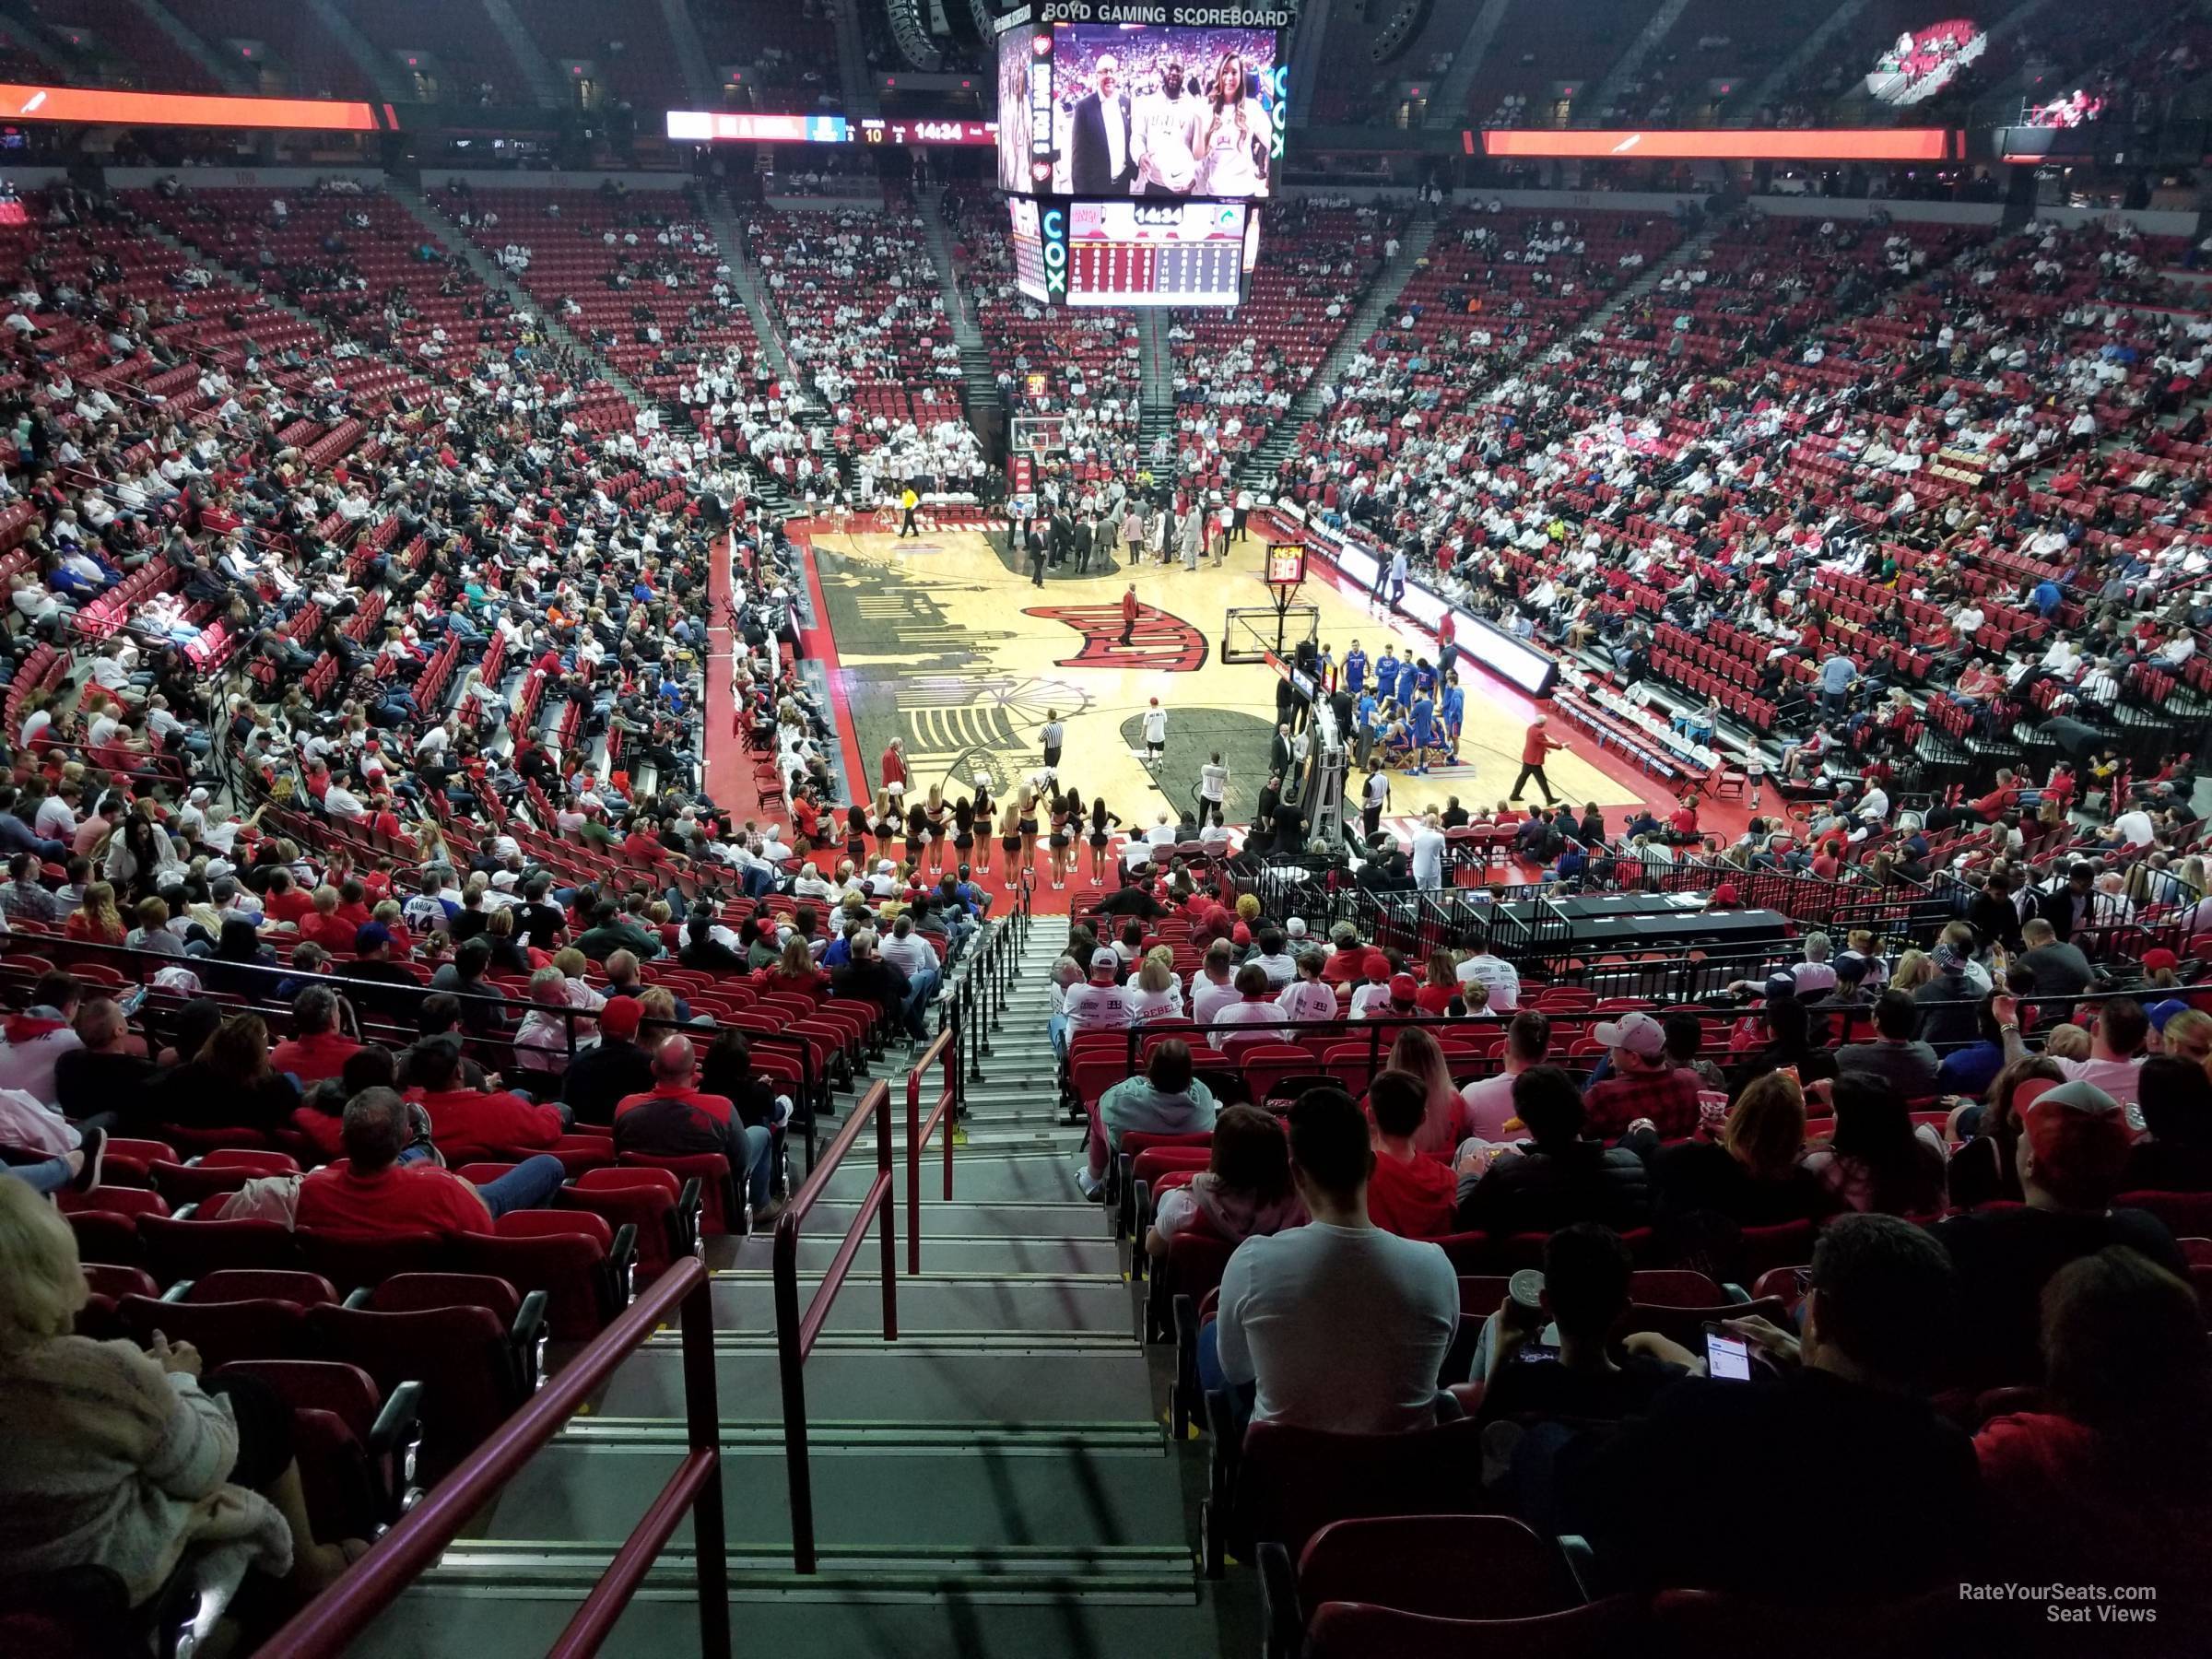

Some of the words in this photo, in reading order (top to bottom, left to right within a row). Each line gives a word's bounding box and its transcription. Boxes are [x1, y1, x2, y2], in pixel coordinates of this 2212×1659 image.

[1045, 3, 1091, 20] BOYD
[1098, 5, 1166, 23] GAMING
[1173, 6, 1288, 26] SCOREBOARD
[1271, 65, 1288, 159] COX
[865, 129, 882, 142] 10
[914, 123, 962, 140] 14:34
[1043, 211, 1066, 293] COX
[410, 901, 433, 913] AARON
[406, 913, 434, 935] 44
[1143, 1001, 1181, 1018] REBELS
